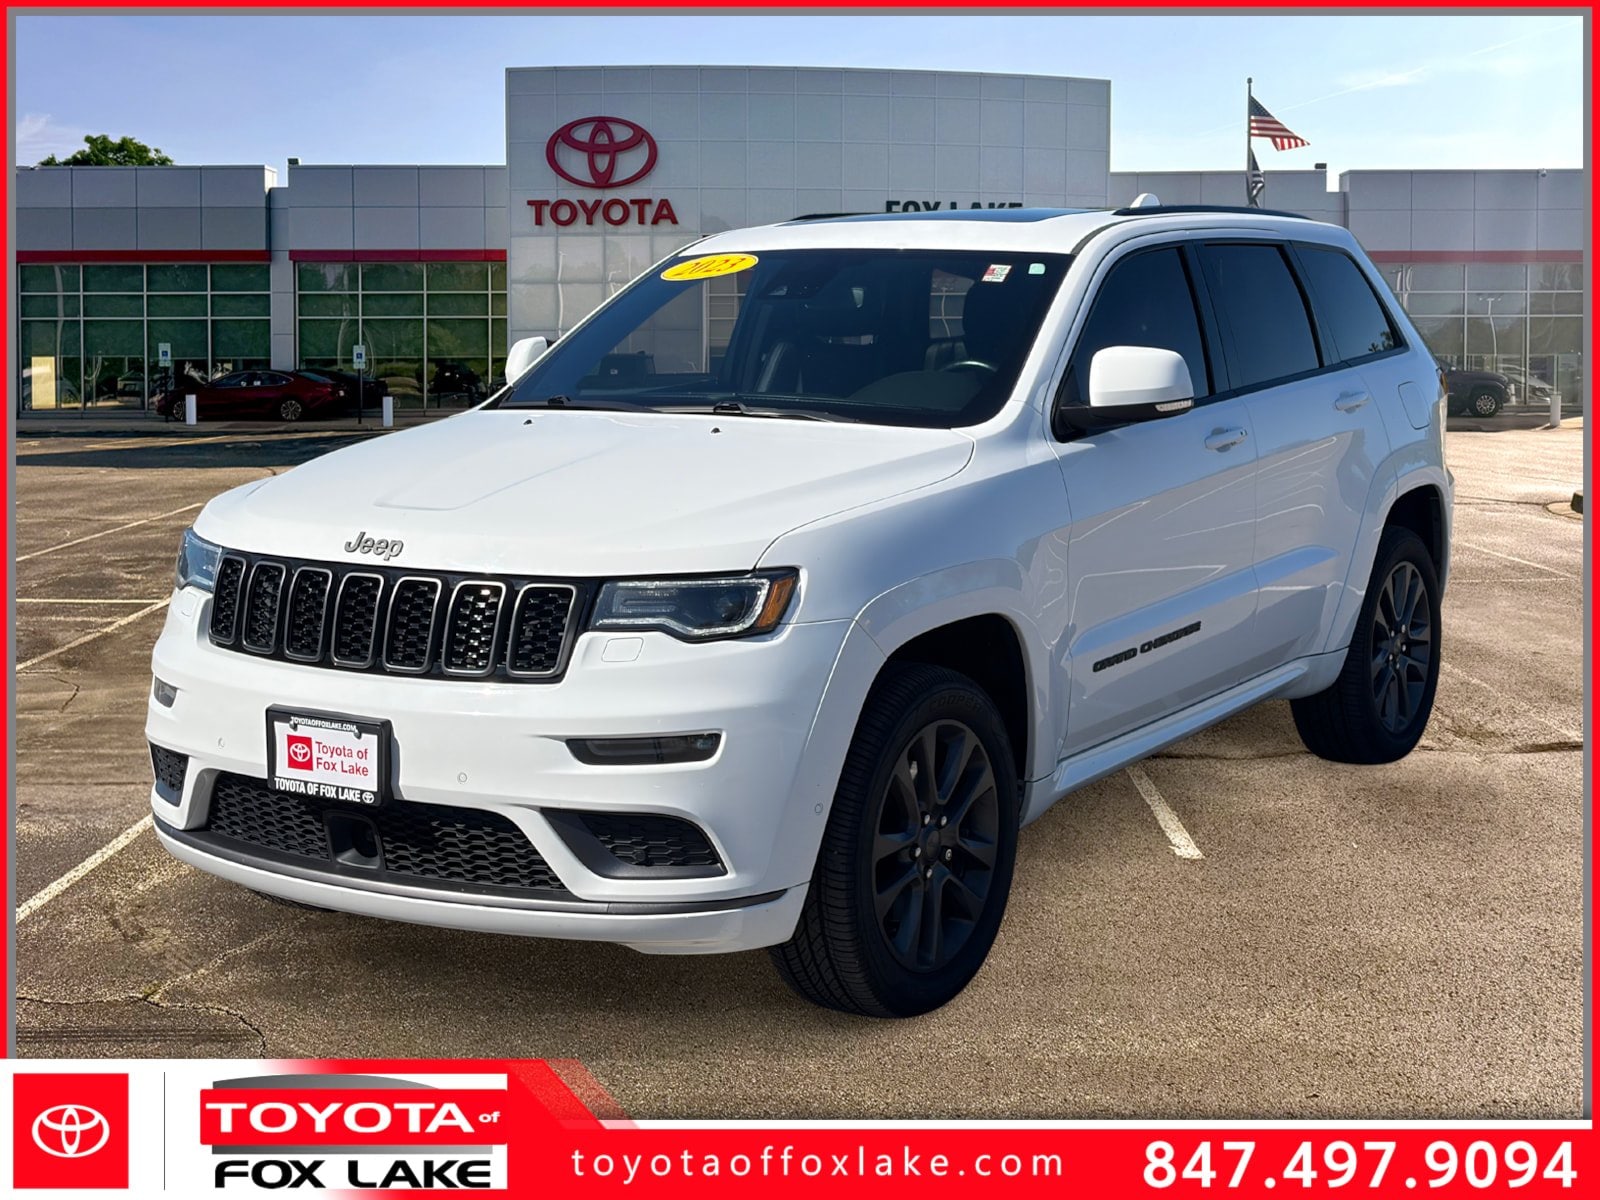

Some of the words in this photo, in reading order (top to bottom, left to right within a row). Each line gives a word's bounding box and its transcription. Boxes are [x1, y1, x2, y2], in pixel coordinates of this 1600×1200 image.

[527, 198, 679, 226] TOYOTA
[672, 257, 746, 277] 2023
[344, 531, 404, 561] Jeep
[1092, 647, 1138, 673] GRAND
[315, 741, 353, 758] Toyota
[356, 748, 369, 760] of
[315, 757, 337, 772] Fox
[340, 761, 369, 777] Lake
[274, 777, 306, 794] TOYOTA
[307, 782, 319, 796] OF
[319, 784, 338, 799] FOX
[338, 787, 361, 803] LAKE
